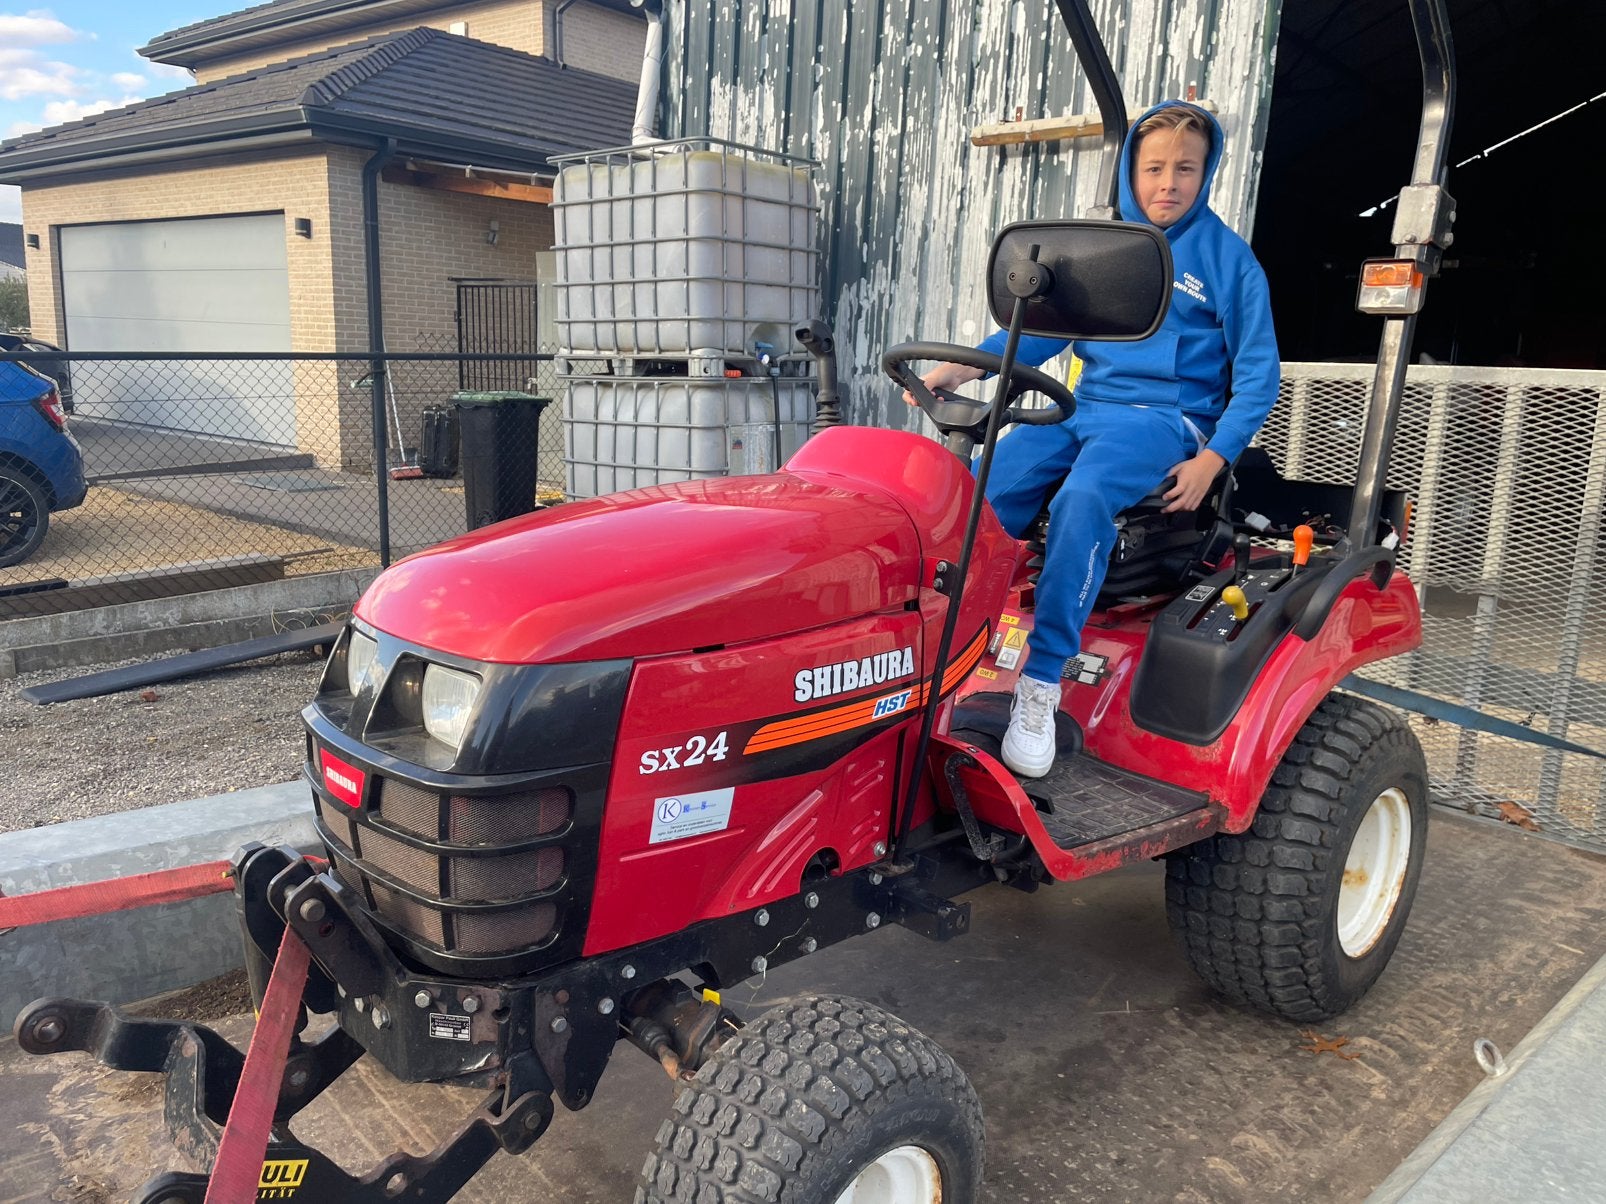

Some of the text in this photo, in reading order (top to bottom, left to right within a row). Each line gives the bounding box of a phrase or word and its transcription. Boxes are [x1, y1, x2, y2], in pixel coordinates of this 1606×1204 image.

[1183, 272, 1204, 289] CREATE
[1184, 279, 1200, 291] YOUR
[1173, 281, 1207, 303] OWN ROUTE
[795, 646, 915, 702] SHIBAURA
[873, 690, 911, 719] HST
[326, 766, 358, 795] SHIBAURA
[662, 802, 676, 820] K
[262, 1164, 303, 1184] ULI
[256, 1186, 296, 1199] ITÄT
